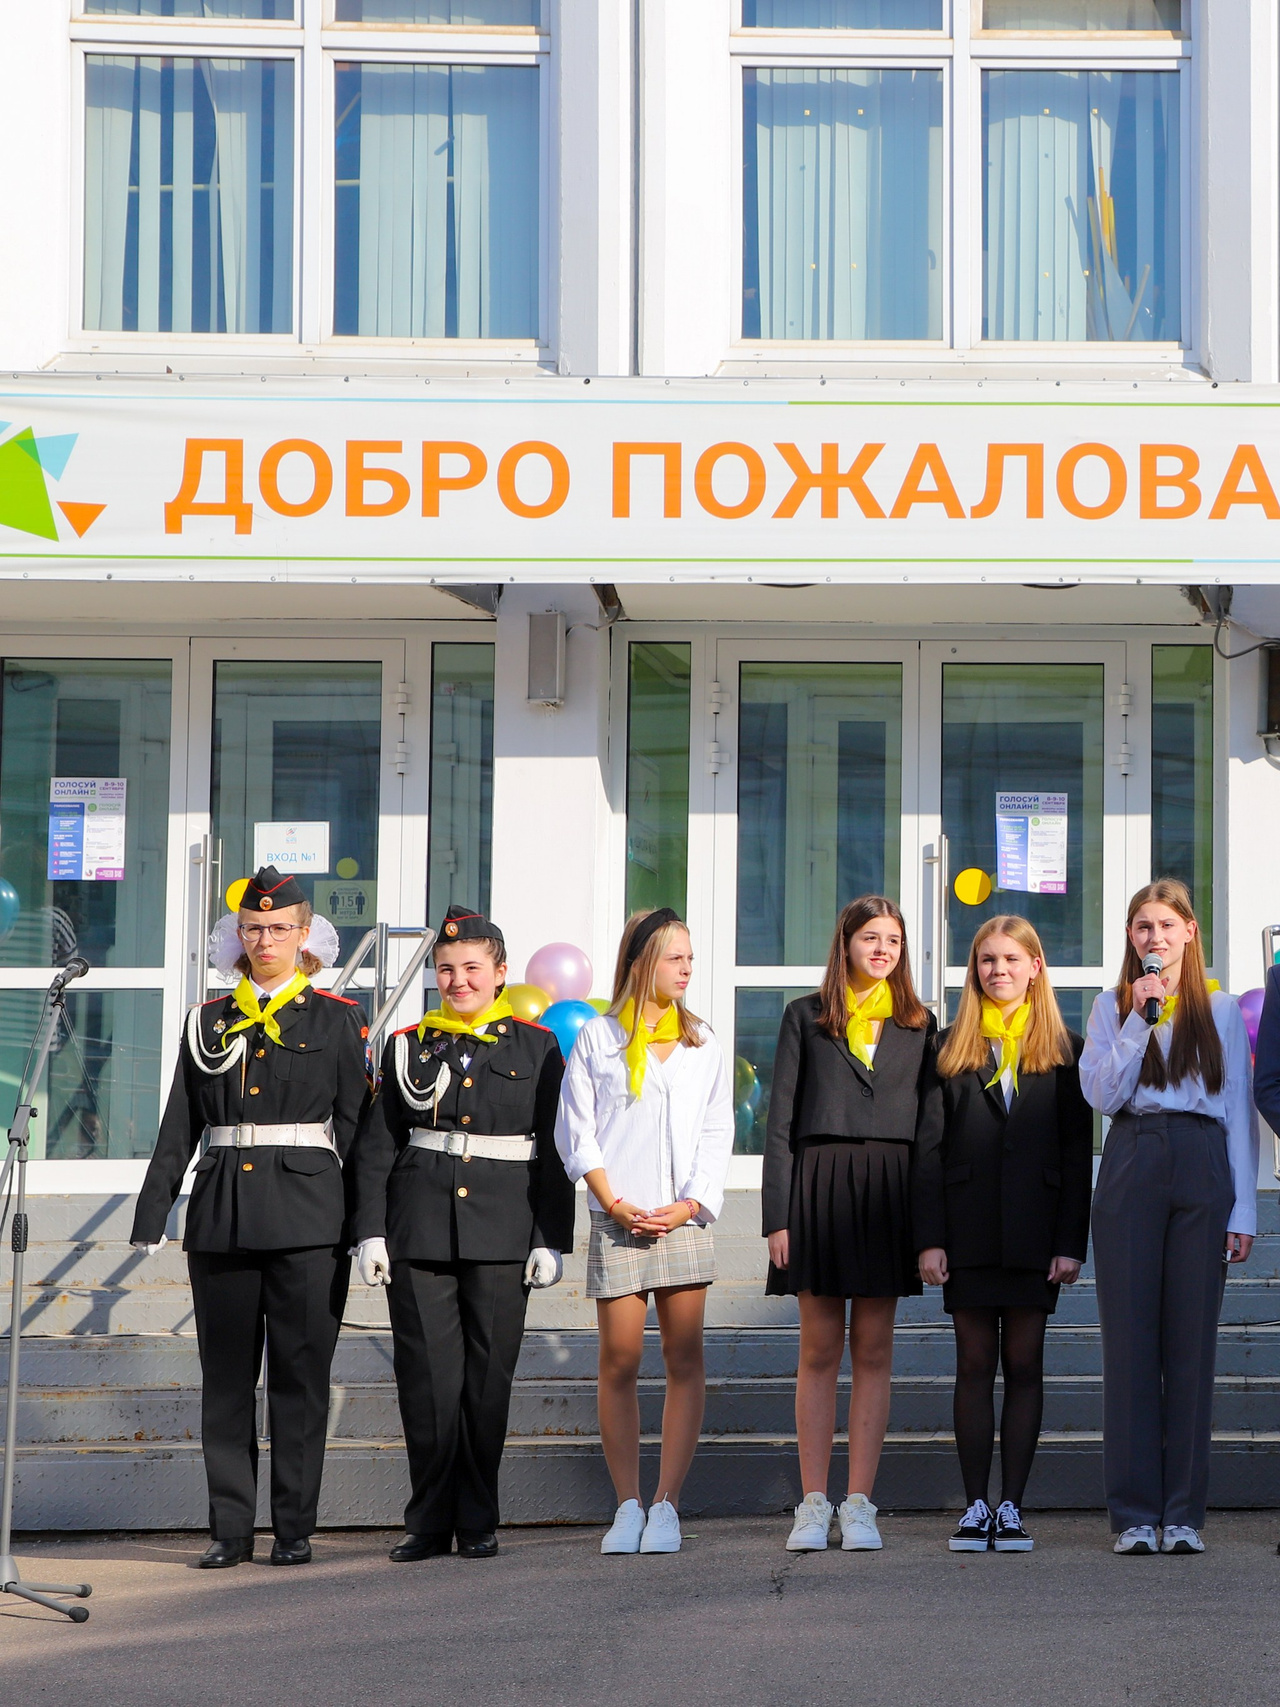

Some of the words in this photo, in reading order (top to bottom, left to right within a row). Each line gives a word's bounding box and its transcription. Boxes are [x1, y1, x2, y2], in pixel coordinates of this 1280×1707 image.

[165, 439, 569, 534] ДОБРО
[54, 780, 96, 788] ГОЛОСУЙ
[54, 788, 89, 796] ОНЛАЙН
[999, 795, 1039, 803] ГОЛОСУЙ
[999, 802, 1033, 810] ОНЛАЙН
[266, 852, 298, 863] ВХОД
[301, 852, 316, 861] №1
